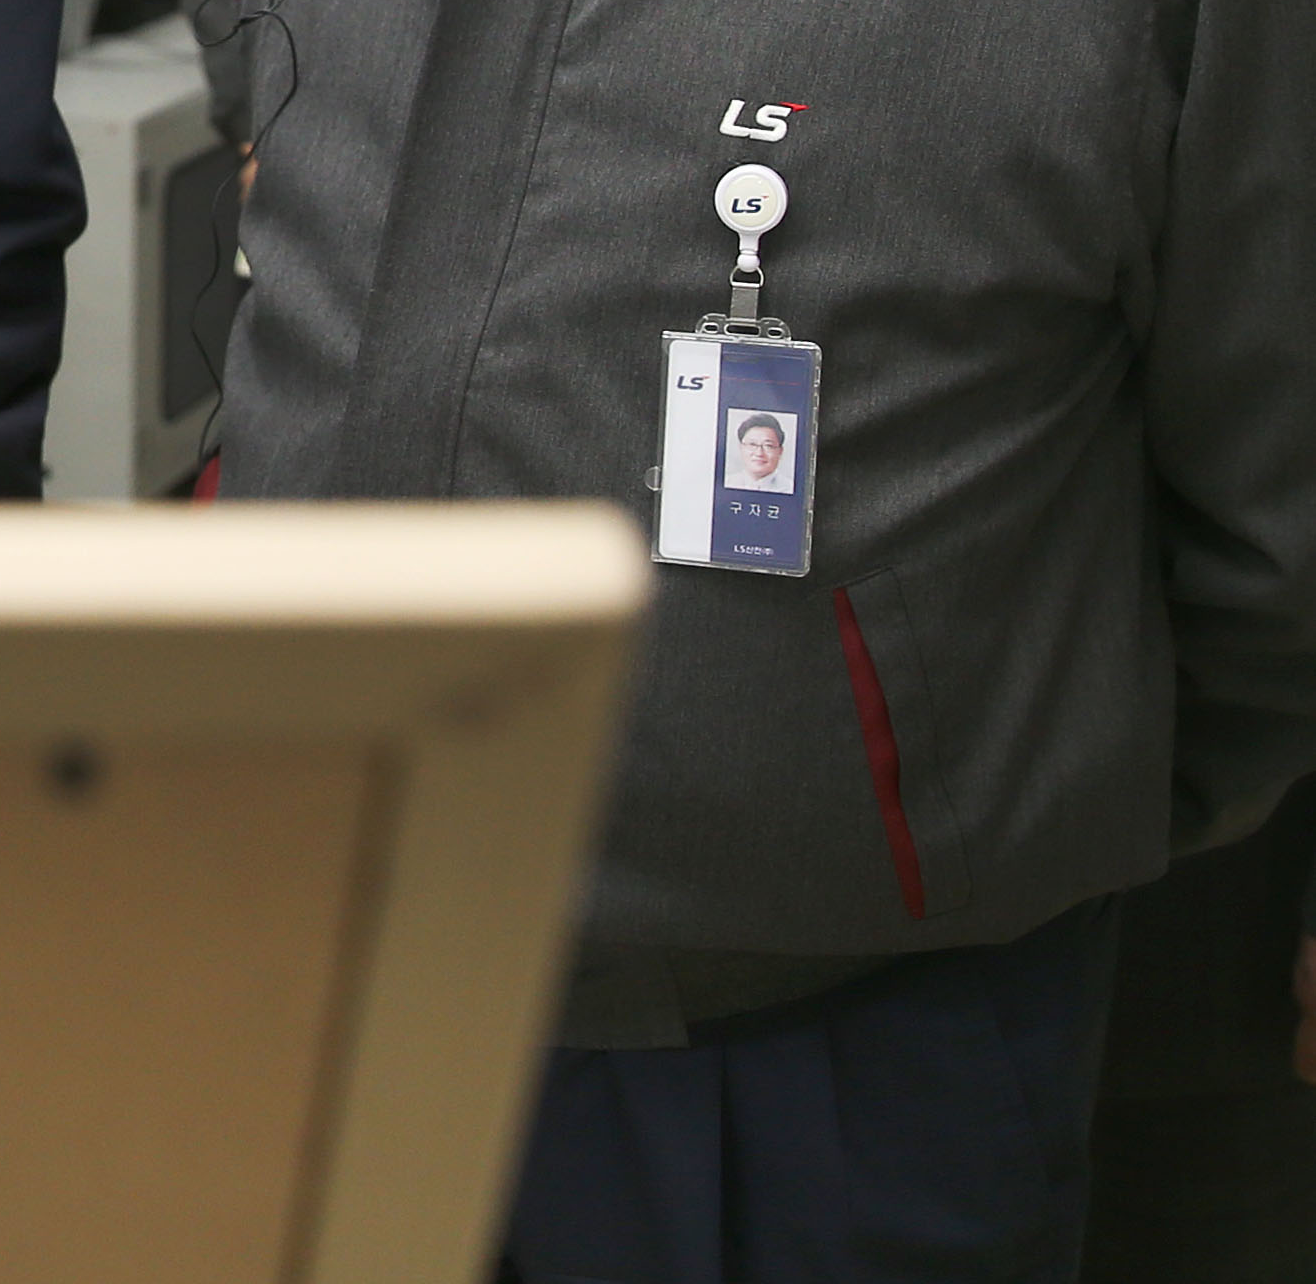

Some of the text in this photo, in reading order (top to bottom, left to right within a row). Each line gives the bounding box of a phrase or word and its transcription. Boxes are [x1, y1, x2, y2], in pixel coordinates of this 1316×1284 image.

[719, 99, 795, 142] LS
[731, 198, 762, 214] LS
[677, 375, 705, 391] LS
